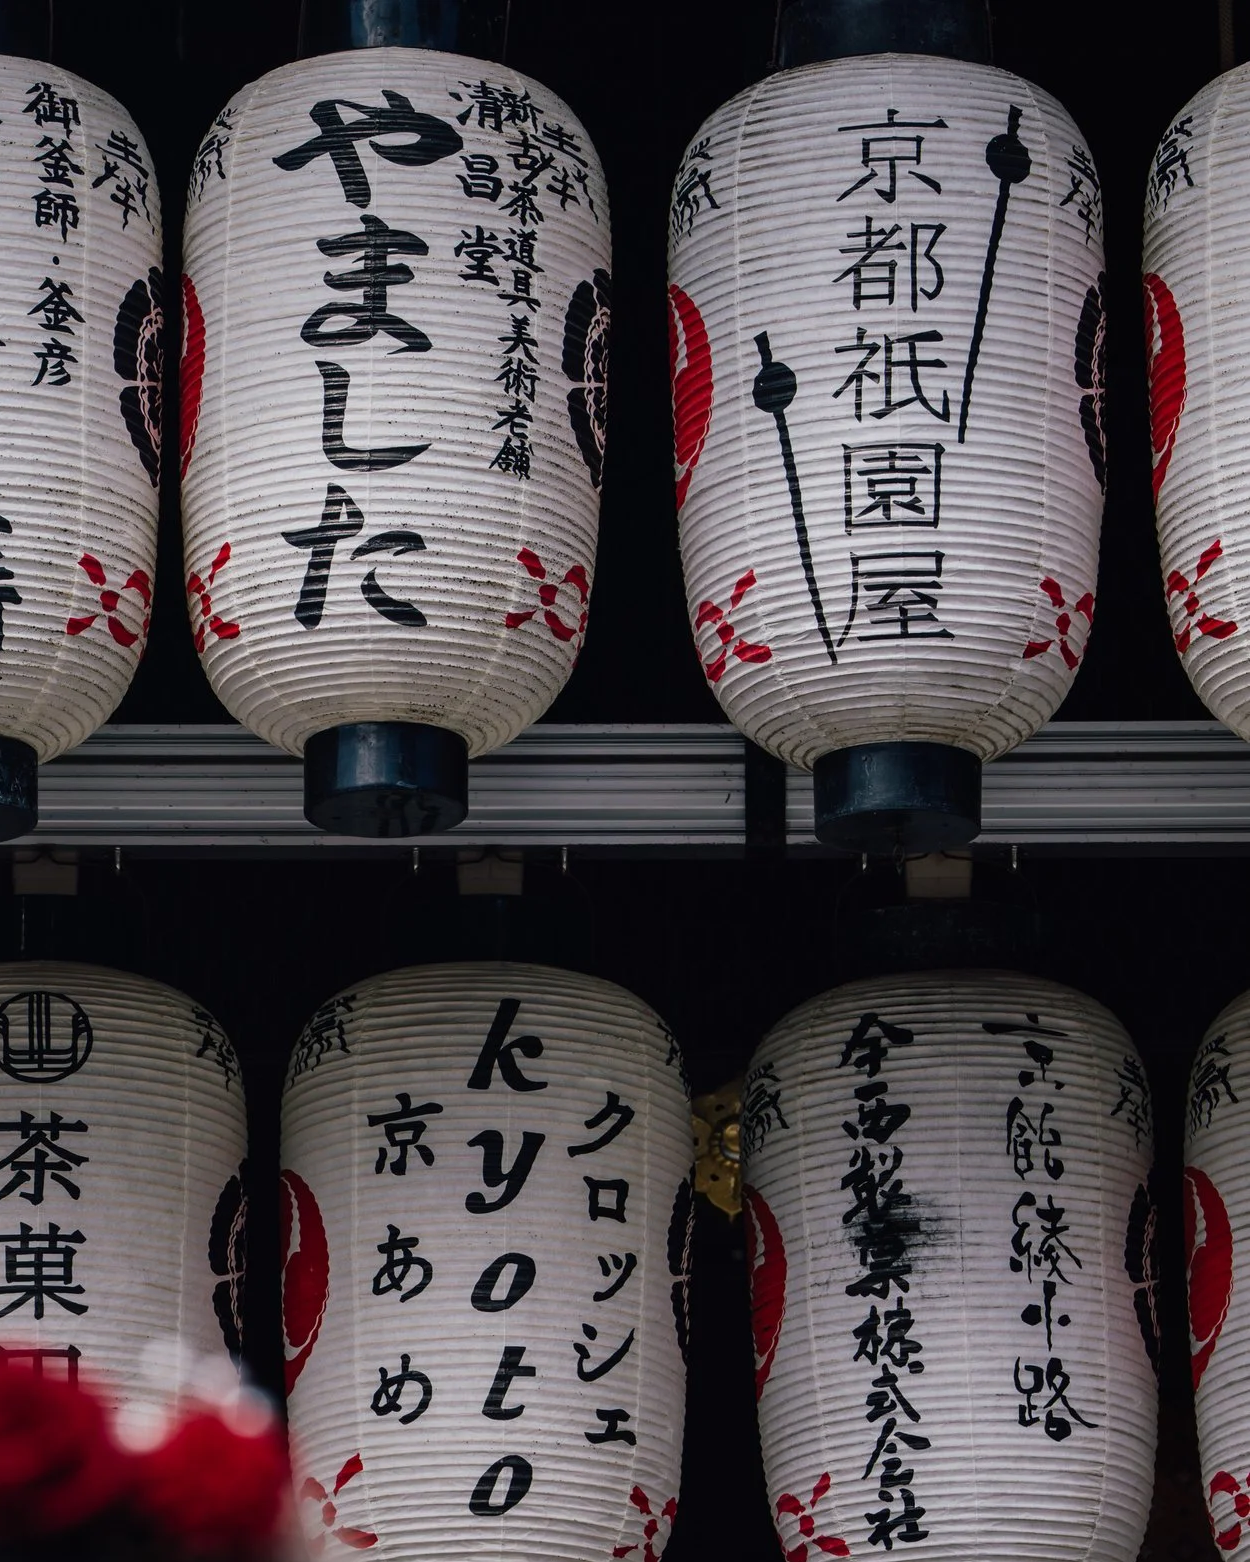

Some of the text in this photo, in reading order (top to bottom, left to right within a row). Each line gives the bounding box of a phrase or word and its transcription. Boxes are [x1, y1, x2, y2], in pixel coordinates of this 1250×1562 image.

[271, 89, 464, 630] やました
[449, 79, 505, 287] 清昌堂
[831, 108, 955, 648] 京都祇園屋
[366, 1092, 444, 1425] 京あめ
[463, 998, 549, 1517] kyoto
[567, 1091, 638, 1447] クロッシェ
